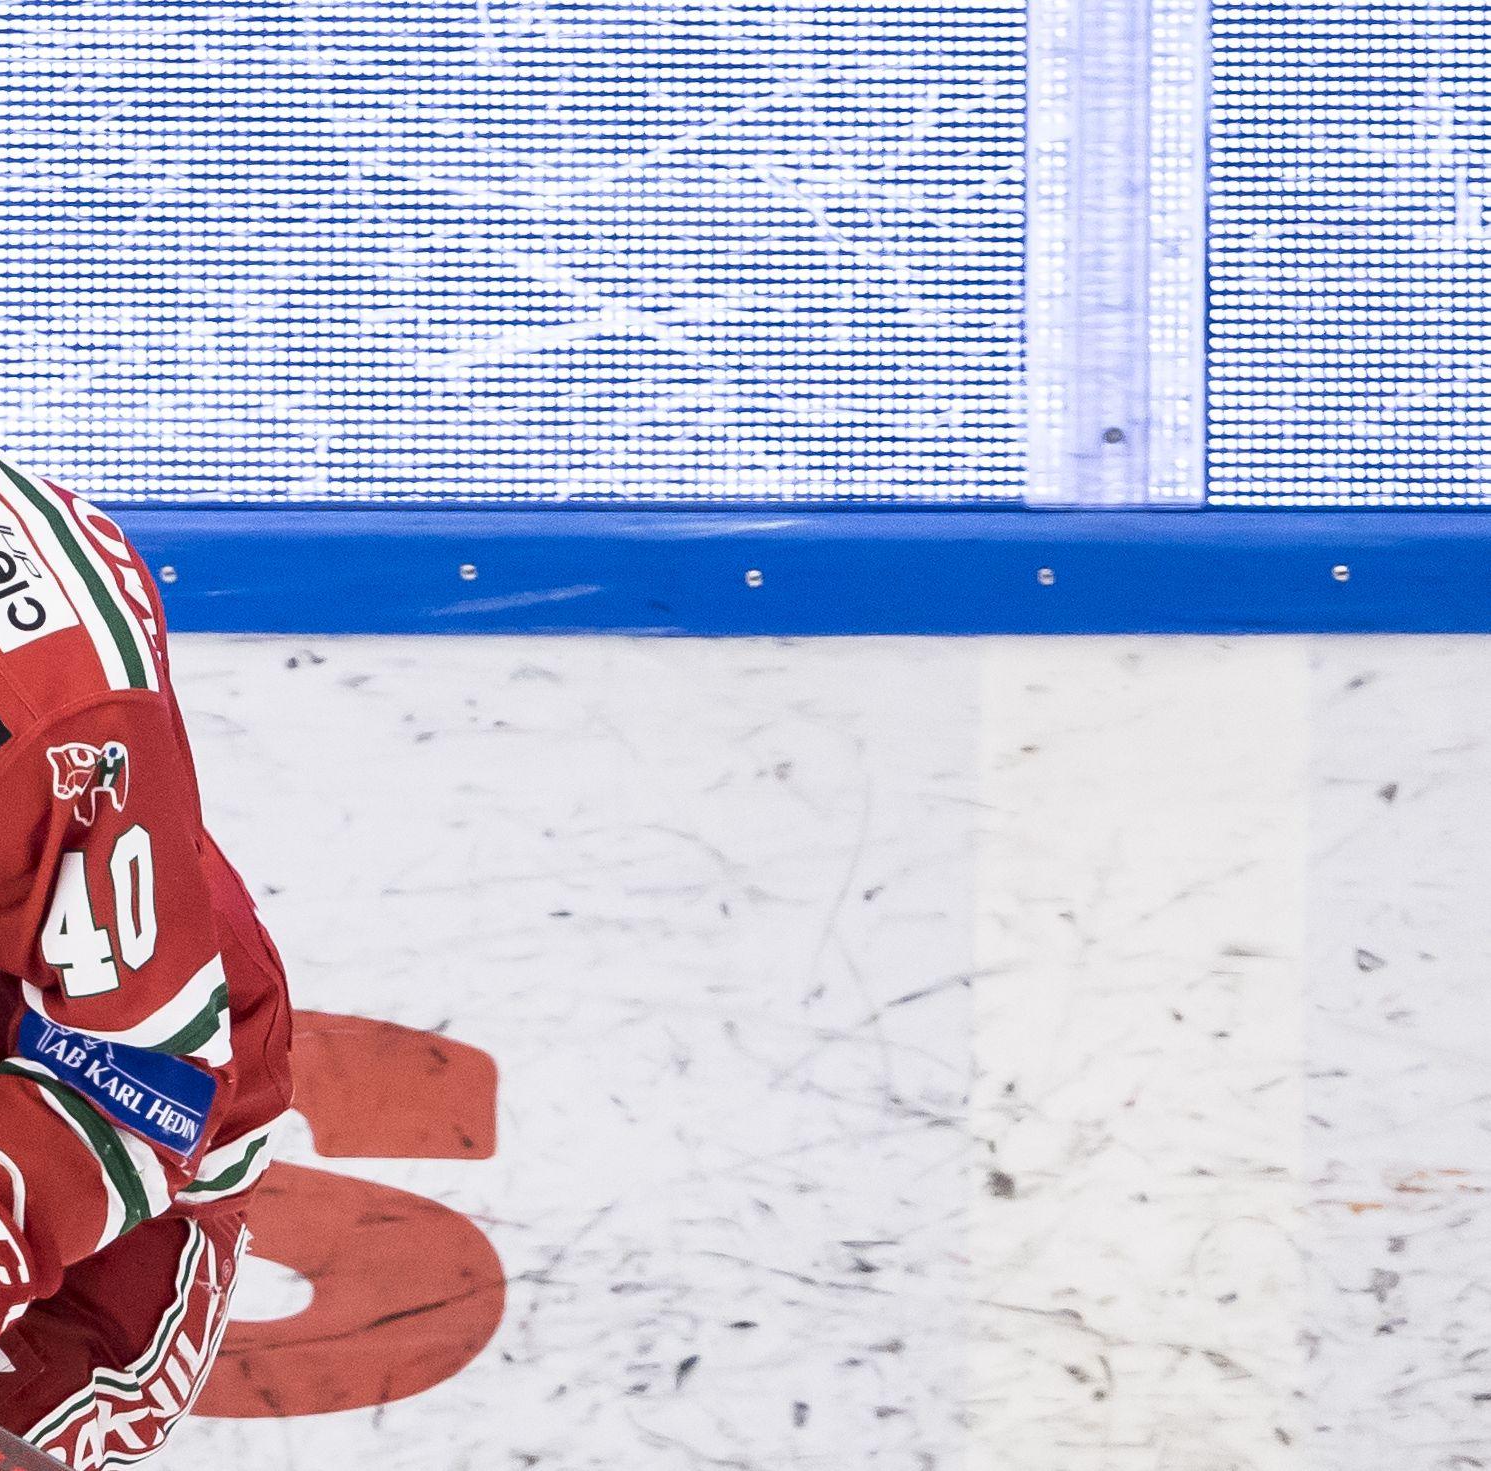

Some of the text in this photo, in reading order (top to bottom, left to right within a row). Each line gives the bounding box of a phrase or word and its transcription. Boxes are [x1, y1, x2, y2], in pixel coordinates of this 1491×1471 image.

[41, 823, 157, 998] 40
[45, 1039, 200, 1143] AB KARL HEDIN
